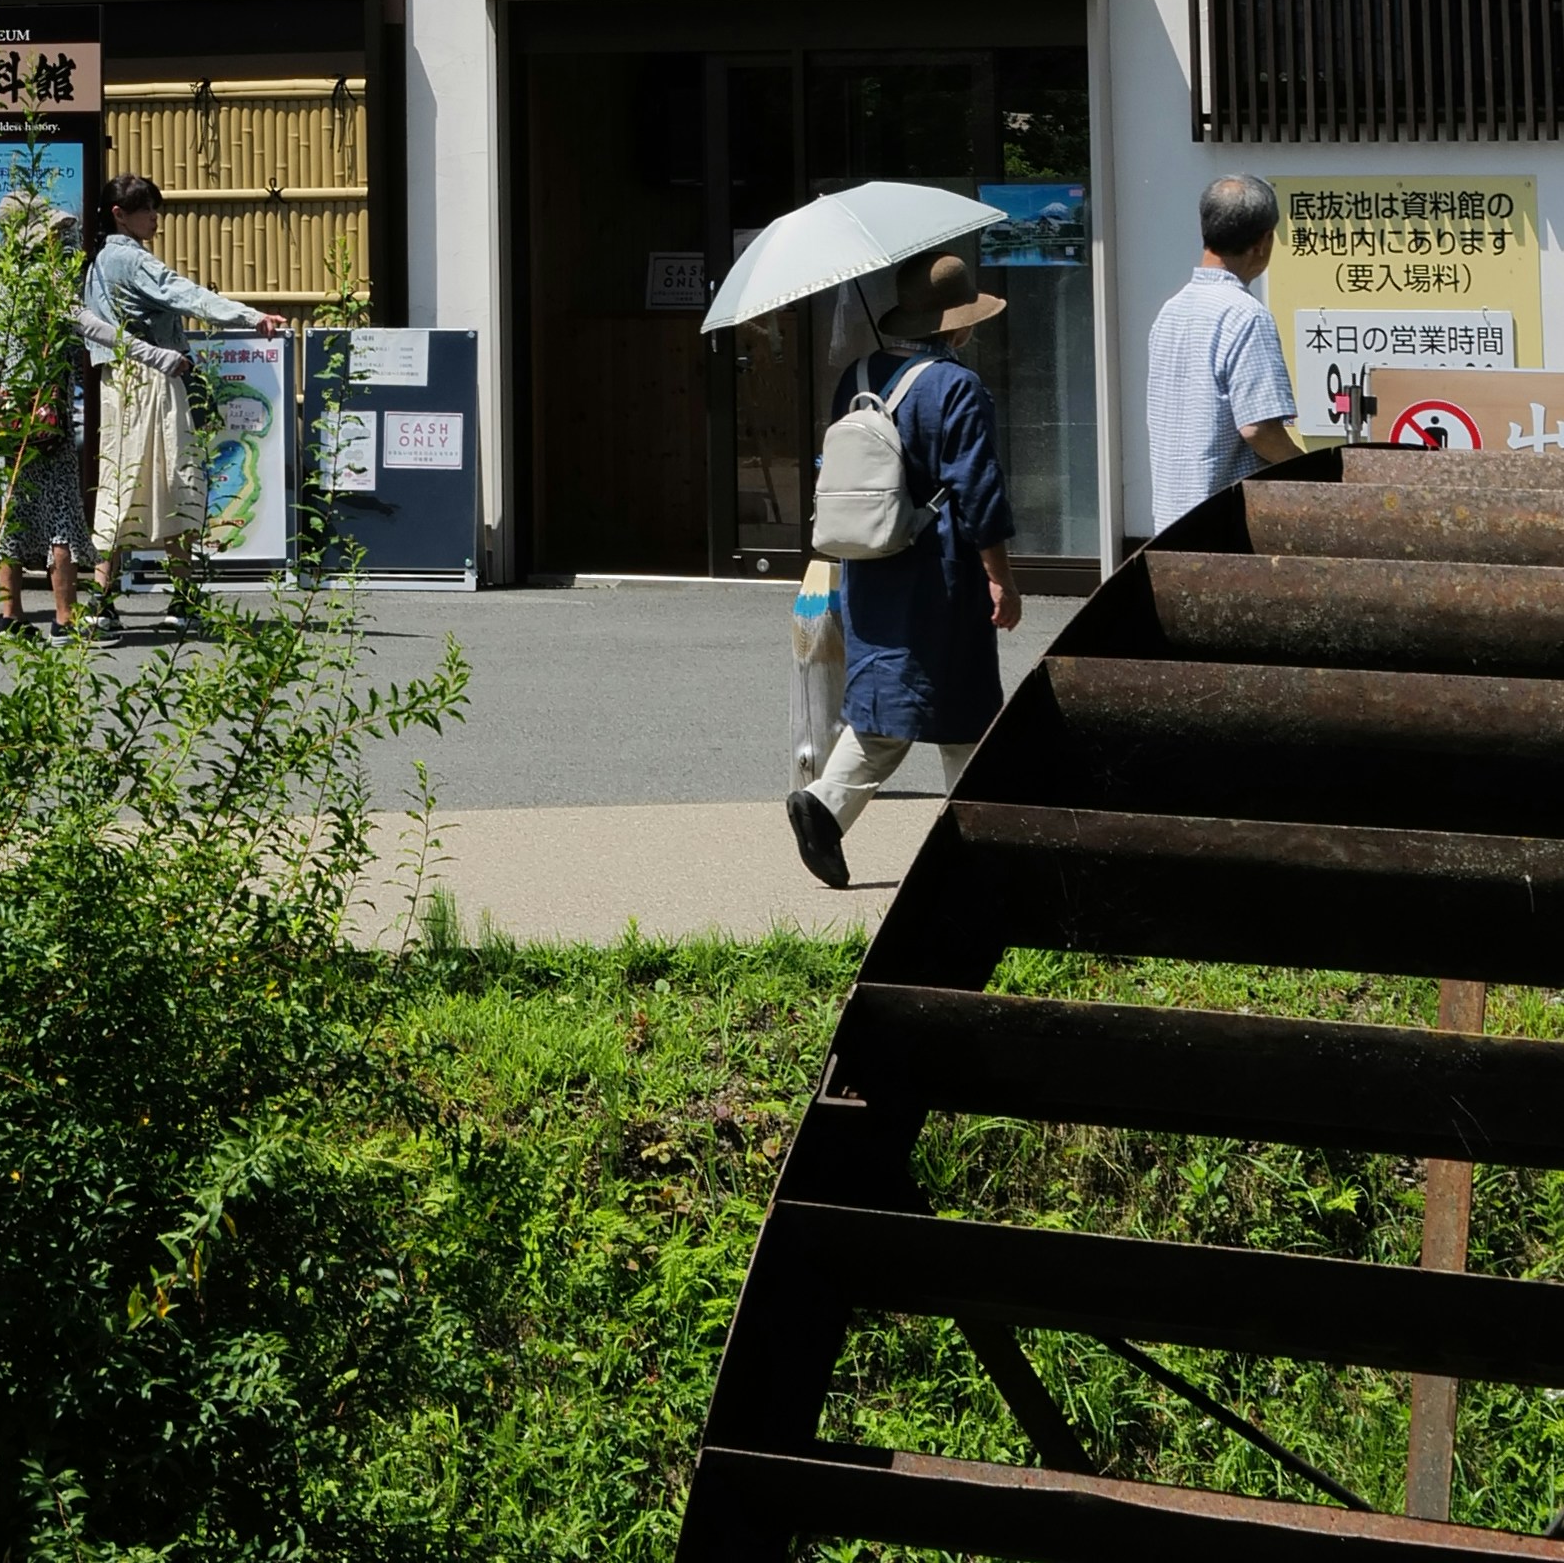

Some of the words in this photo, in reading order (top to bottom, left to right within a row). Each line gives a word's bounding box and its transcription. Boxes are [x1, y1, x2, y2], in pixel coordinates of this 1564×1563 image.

[1289, 191, 1515, 221] 底抜池は資料館の
[1291, 227, 1514, 257] 敷地内にあります
[1335, 263, 1472, 293] （要入場料）
[1304, 323, 1504, 356] 本日の営業時間
[398, 435, 449, 448] ONLY
[399, 422, 449, 435] CASH
